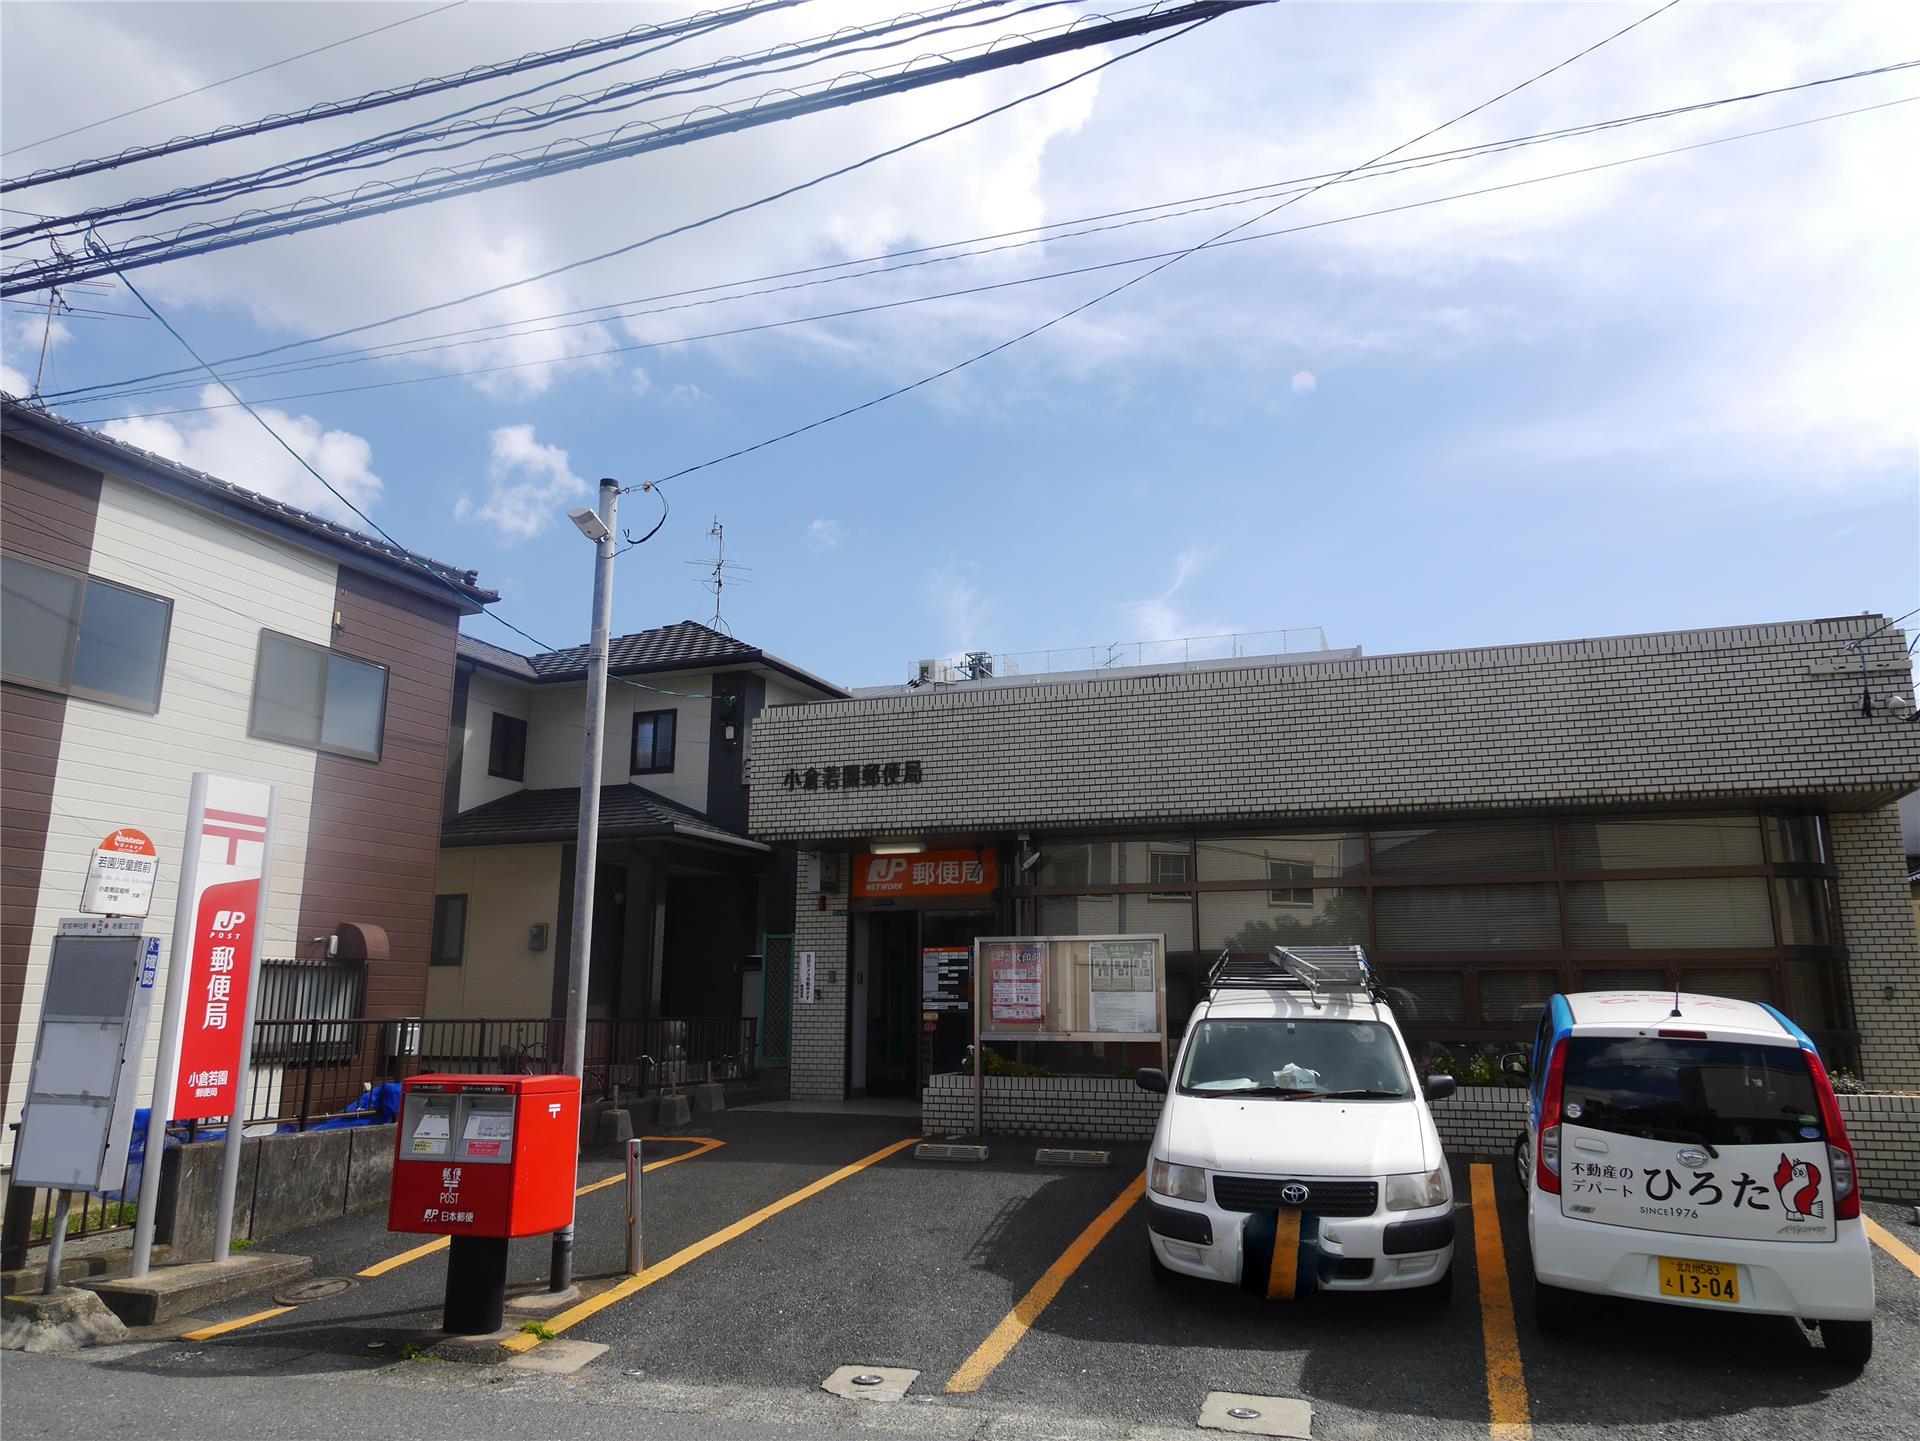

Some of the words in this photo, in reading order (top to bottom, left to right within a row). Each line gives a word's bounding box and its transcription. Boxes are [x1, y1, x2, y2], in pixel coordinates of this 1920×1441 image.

[784, 760, 921, 791] 小倉若園郵便局
[98, 856, 152, 873] 若園児童館前
[867, 858, 907, 882] JP
[912, 860, 984, 886] 郵便局
[865, 881, 903, 891] NETWORK
[212, 910, 245, 931] JP
[209, 932, 241, 940] POST
[142, 953, 158, 986] 確認
[202, 946, 235, 1030] 郵便局
[188, 1070, 229, 1087] 小倉若園
[195, 1087, 218, 1098] 郵便局
[442, 1167, 462, 1181] 郵便
[1570, 1162, 1634, 1180] 不動産の
[440, 1192, 460, 1204] POST
[1572, 1180, 1633, 1198] デパート
[1643, 1168, 1770, 1210] ひろた
[441, 1211, 474, 1223] 日本郵便
[1640, 1206, 1699, 1219] SINCE1976
[1680, 1274, 1734, 1299] 13-04
